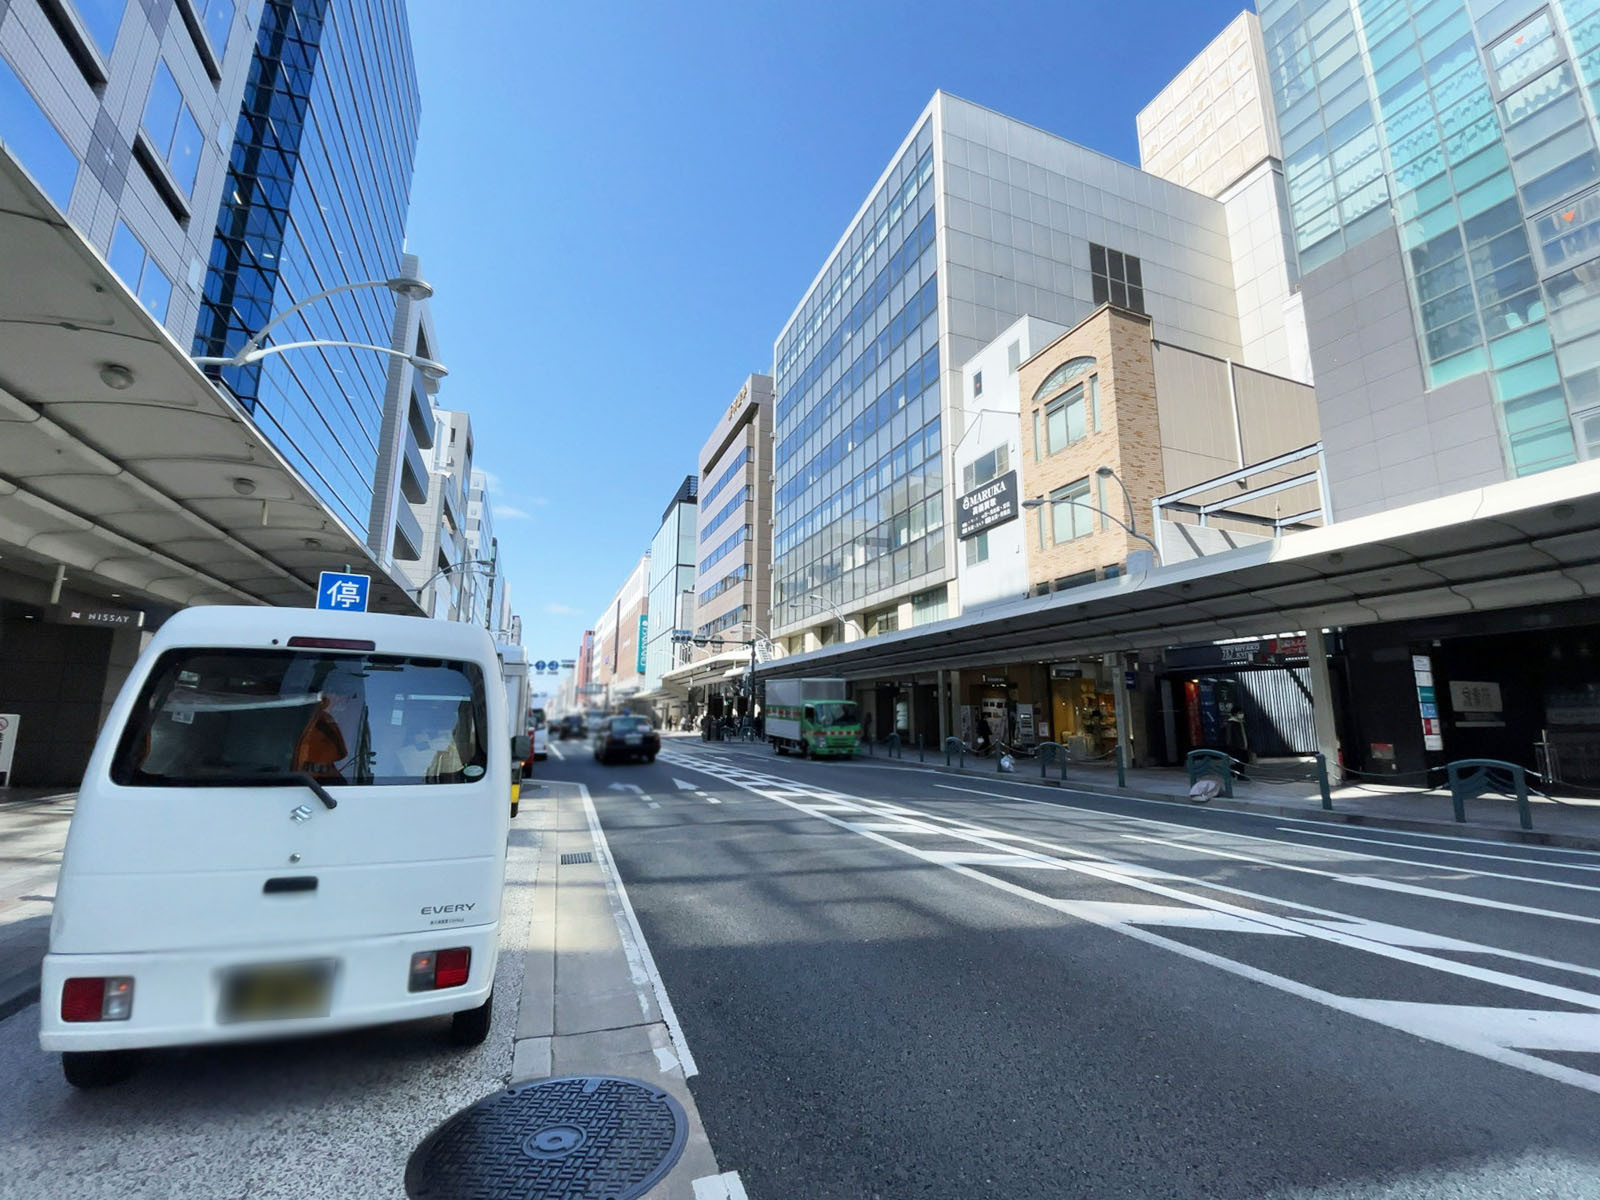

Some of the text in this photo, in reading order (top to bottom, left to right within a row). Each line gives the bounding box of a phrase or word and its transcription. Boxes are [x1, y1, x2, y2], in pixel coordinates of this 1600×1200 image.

[969, 481, 1007, 507] MARUKA
[326, 580, 360, 608] 停
[88, 613, 130, 623] NISSAY
[420, 902, 476, 915] EVERY
